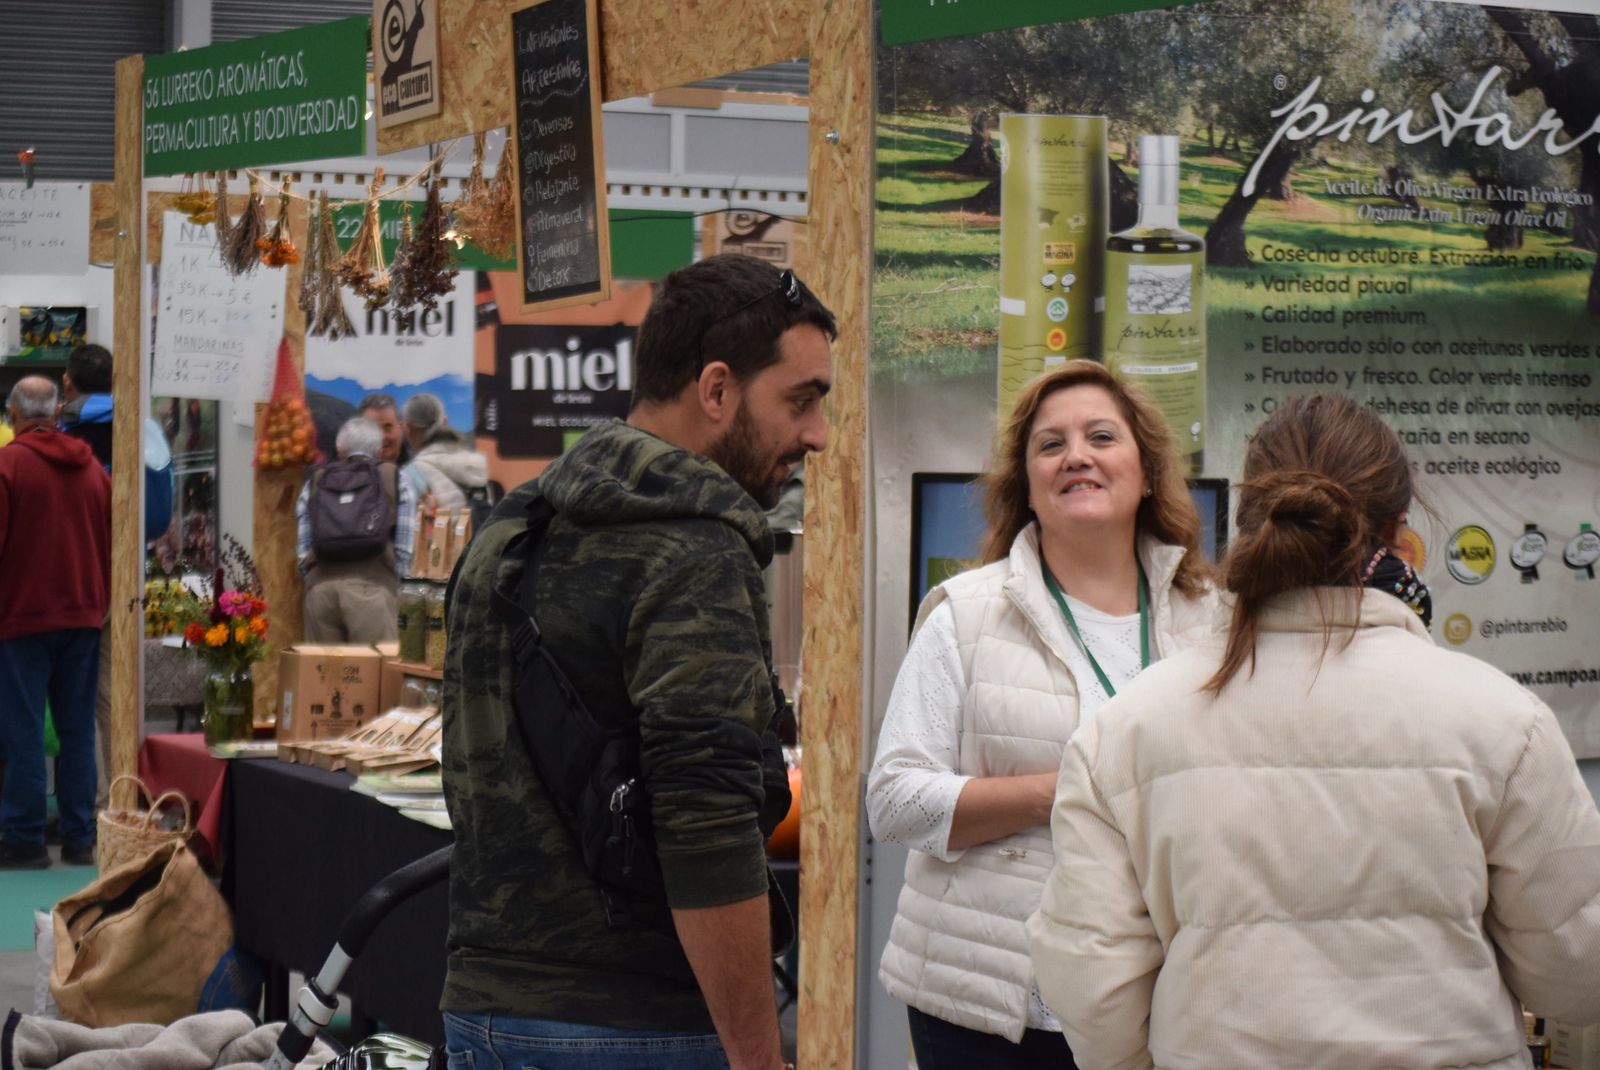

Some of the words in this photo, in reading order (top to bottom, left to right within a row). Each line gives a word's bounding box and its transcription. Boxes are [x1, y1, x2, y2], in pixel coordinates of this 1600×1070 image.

[145, 79, 159, 109] 56
[161, 67, 214, 107] LURREKO
[216, 51, 308, 98] AROMÁTICAS,
[400, 73, 429, 100] cultura
[145, 112, 239, 156] PERMACULTURA
[242, 112, 251, 144] Y
[254, 96, 359, 143] BIODIVERSIDAD
[535, 170, 580, 205] Relajante
[1324, 178, 1369, 196] Aceite
[1372, 179, 1392, 197] de
[1394, 178, 1431, 199] Oliva
[1432, 183, 1483, 202] Virgen
[1485, 183, 1528, 203] Extra
[337, 217, 363, 239] 22
[1357, 202, 1414, 225] Organic
[1416, 204, 1453, 224] Extra
[1455, 204, 1501, 228] Virgin
[1503, 208, 1544, 229] Olive
[1545, 208, 1568, 230] Oil
[1262, 243, 1341, 263] Cosecha
[1347, 245, 1423, 264] octubre.
[1430, 249, 1517, 268] Extracción
[1524, 255, 1548, 269] en
[1262, 274, 1350, 293] Variedad
[1358, 275, 1412, 300] picual
[1261, 304, 1336, 325] Calidad
[1342, 305, 1426, 330] premium
[1261, 335, 1362, 355] Elaborado
[1367, 334, 1406, 355] sólo
[1411, 340, 1443, 355] con
[1450, 336, 1525, 357] aceitunas
[1530, 340, 1589, 359] verdes
[511, 338, 632, 391] miel
[1261, 366, 1338, 385] Frutado
[1344, 371, 1357, 390] y
[1362, 365, 1422, 385] fresco.
[1429, 367, 1474, 386] Color
[1478, 368, 1523, 387] verde
[1527, 368, 1592, 388] intenso
[532, 417, 556, 427] MIEL
[1436, 396, 1459, 415] de
[1464, 396, 1510, 415] olivar
[1515, 400, 1542, 415] con
[1546, 398, 1600, 422] ovejas
[1448, 431, 1469, 445] en
[1474, 431, 1530, 446] secano
[1425, 456, 1480, 475] aceite
[1485, 455, 1562, 480] ecológico
[1479, 616, 1569, 639] @pintarrebio
